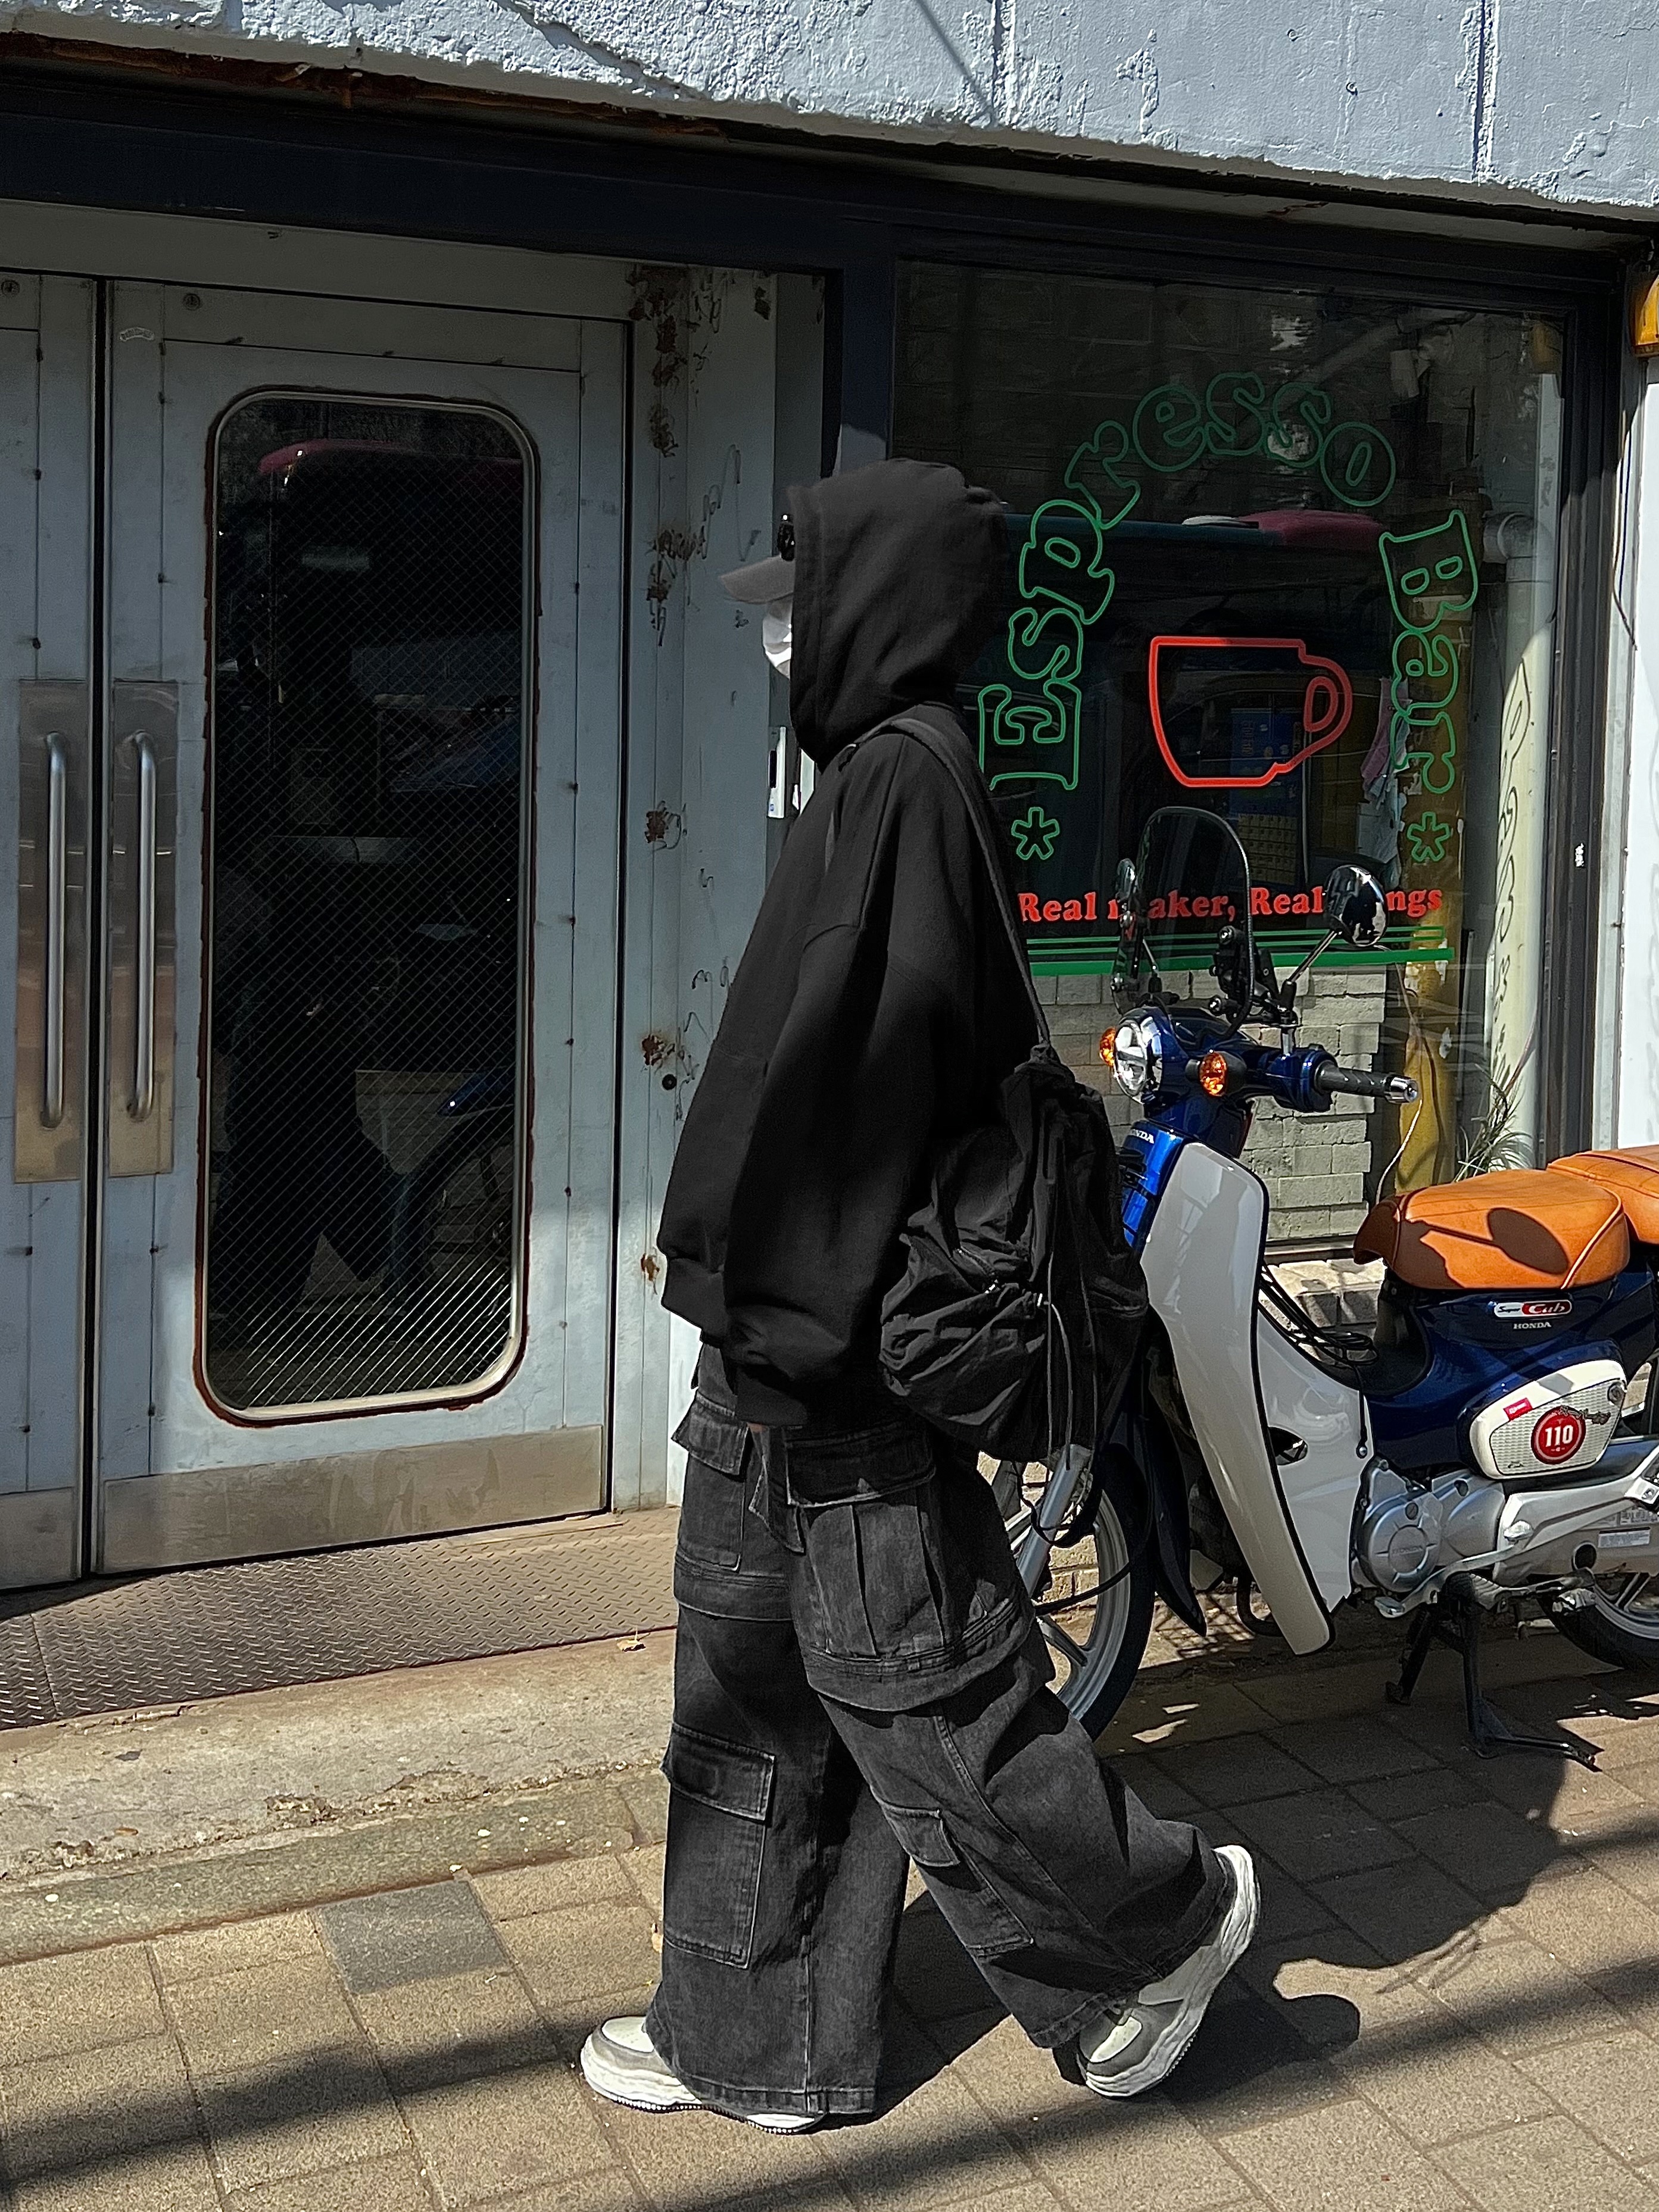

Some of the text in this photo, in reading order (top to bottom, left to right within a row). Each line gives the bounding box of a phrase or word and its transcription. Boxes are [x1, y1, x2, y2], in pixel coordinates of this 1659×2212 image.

[978, 372, 1479, 794] Espresso Bar
[1018, 891, 1097, 922] Real
[1251, 886, 1324, 915] Real
[1386, 889, 1443, 918] ngs
[1545, 1424, 1574, 1447] 110
